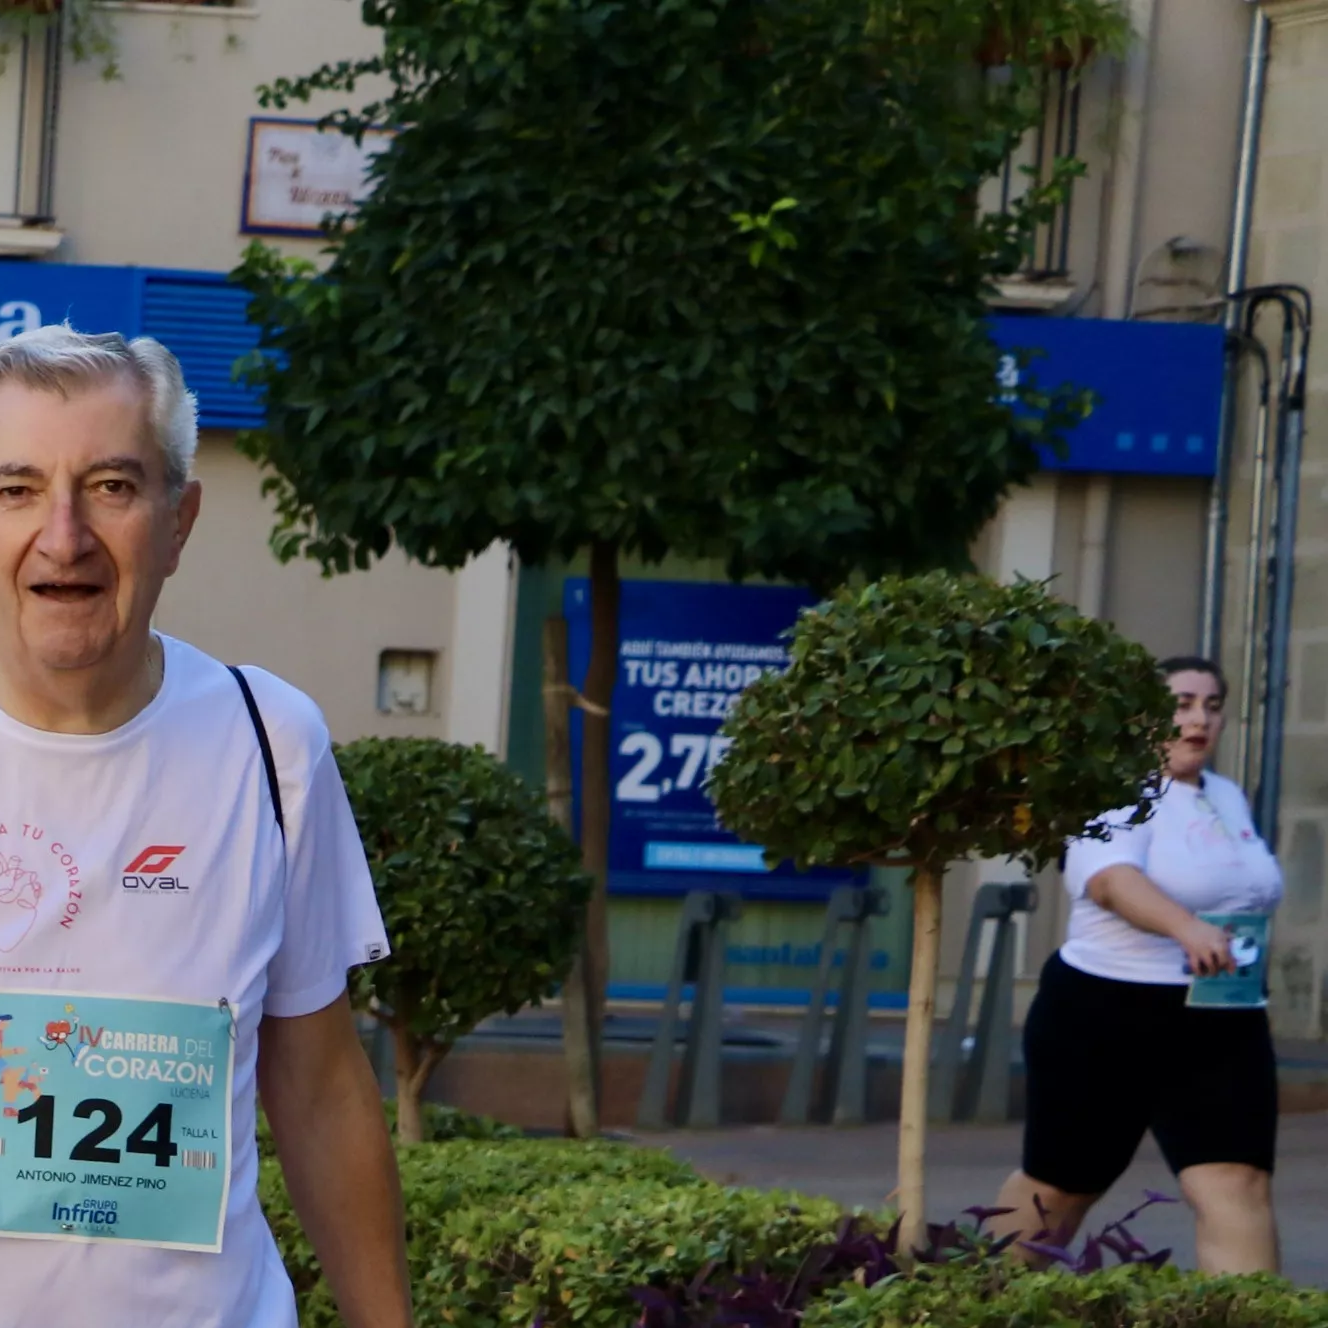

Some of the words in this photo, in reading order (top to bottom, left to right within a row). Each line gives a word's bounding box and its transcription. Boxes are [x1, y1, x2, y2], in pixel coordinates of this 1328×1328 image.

[624, 660, 680, 686] TUS
[22, 823, 44, 840] TU
[78, 1024, 104, 1047] IV
[101, 1030, 179, 1055] CARRERA
[185, 1039, 215, 1059] DEL
[170, 1087, 211, 1100] LUCENA
[17, 1094, 178, 1168] 124
[182, 1126, 208, 1139] TALLA
[16, 1169, 76, 1184] ANTONIO
[80, 1172, 133, 1188] JIMENEZ
[136, 1177, 167, 1190] PINO
[52, 1202, 117, 1225] Infrico
[83, 1199, 118, 1211] GRUPO
